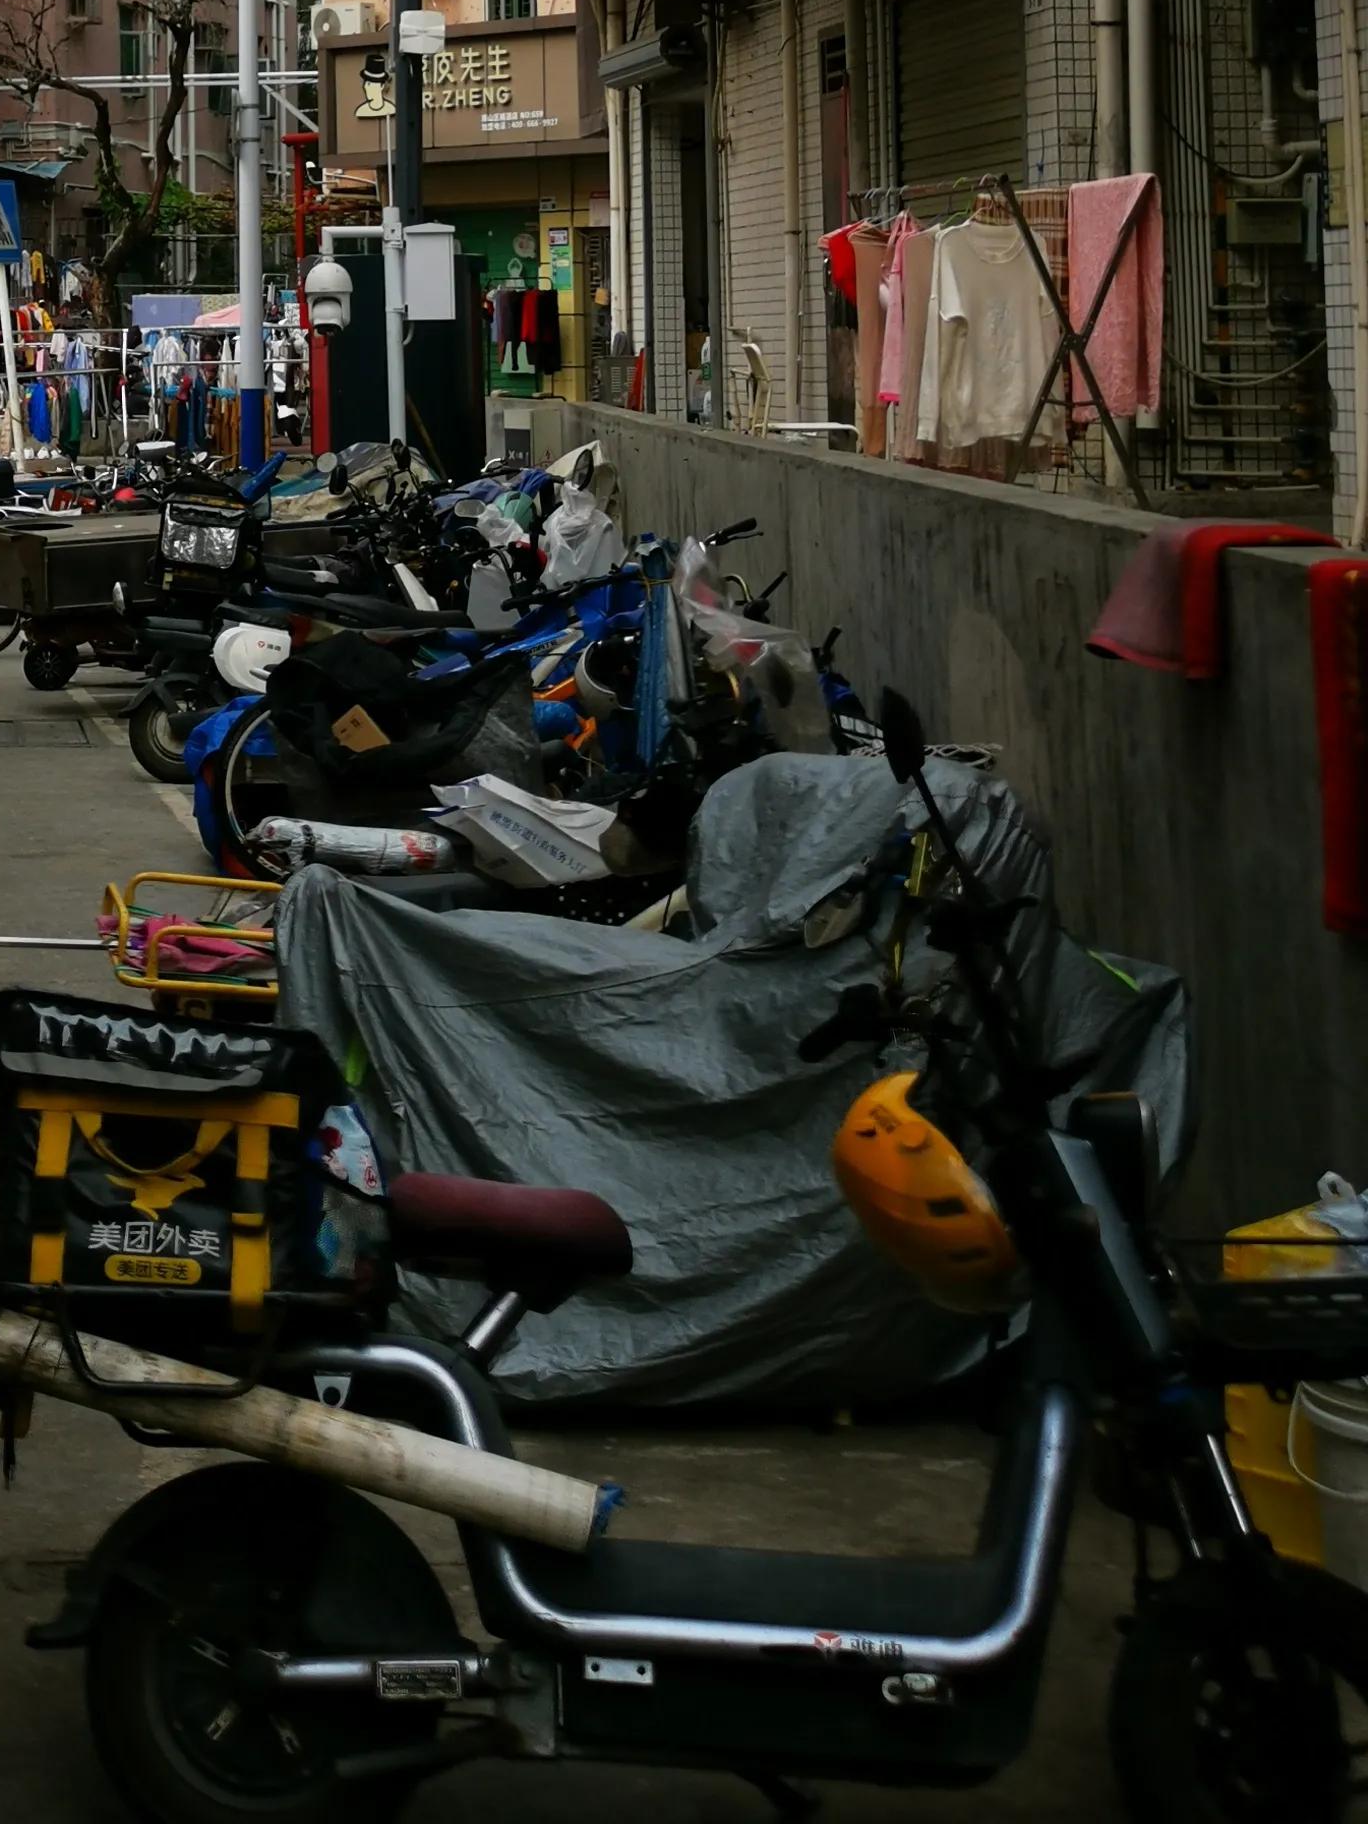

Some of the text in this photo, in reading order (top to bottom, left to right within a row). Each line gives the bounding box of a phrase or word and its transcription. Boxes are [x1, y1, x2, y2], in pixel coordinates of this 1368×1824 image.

[88, 1220, 221, 1258] 美团外卖
[116, 1259, 190, 1281] 美团专送
